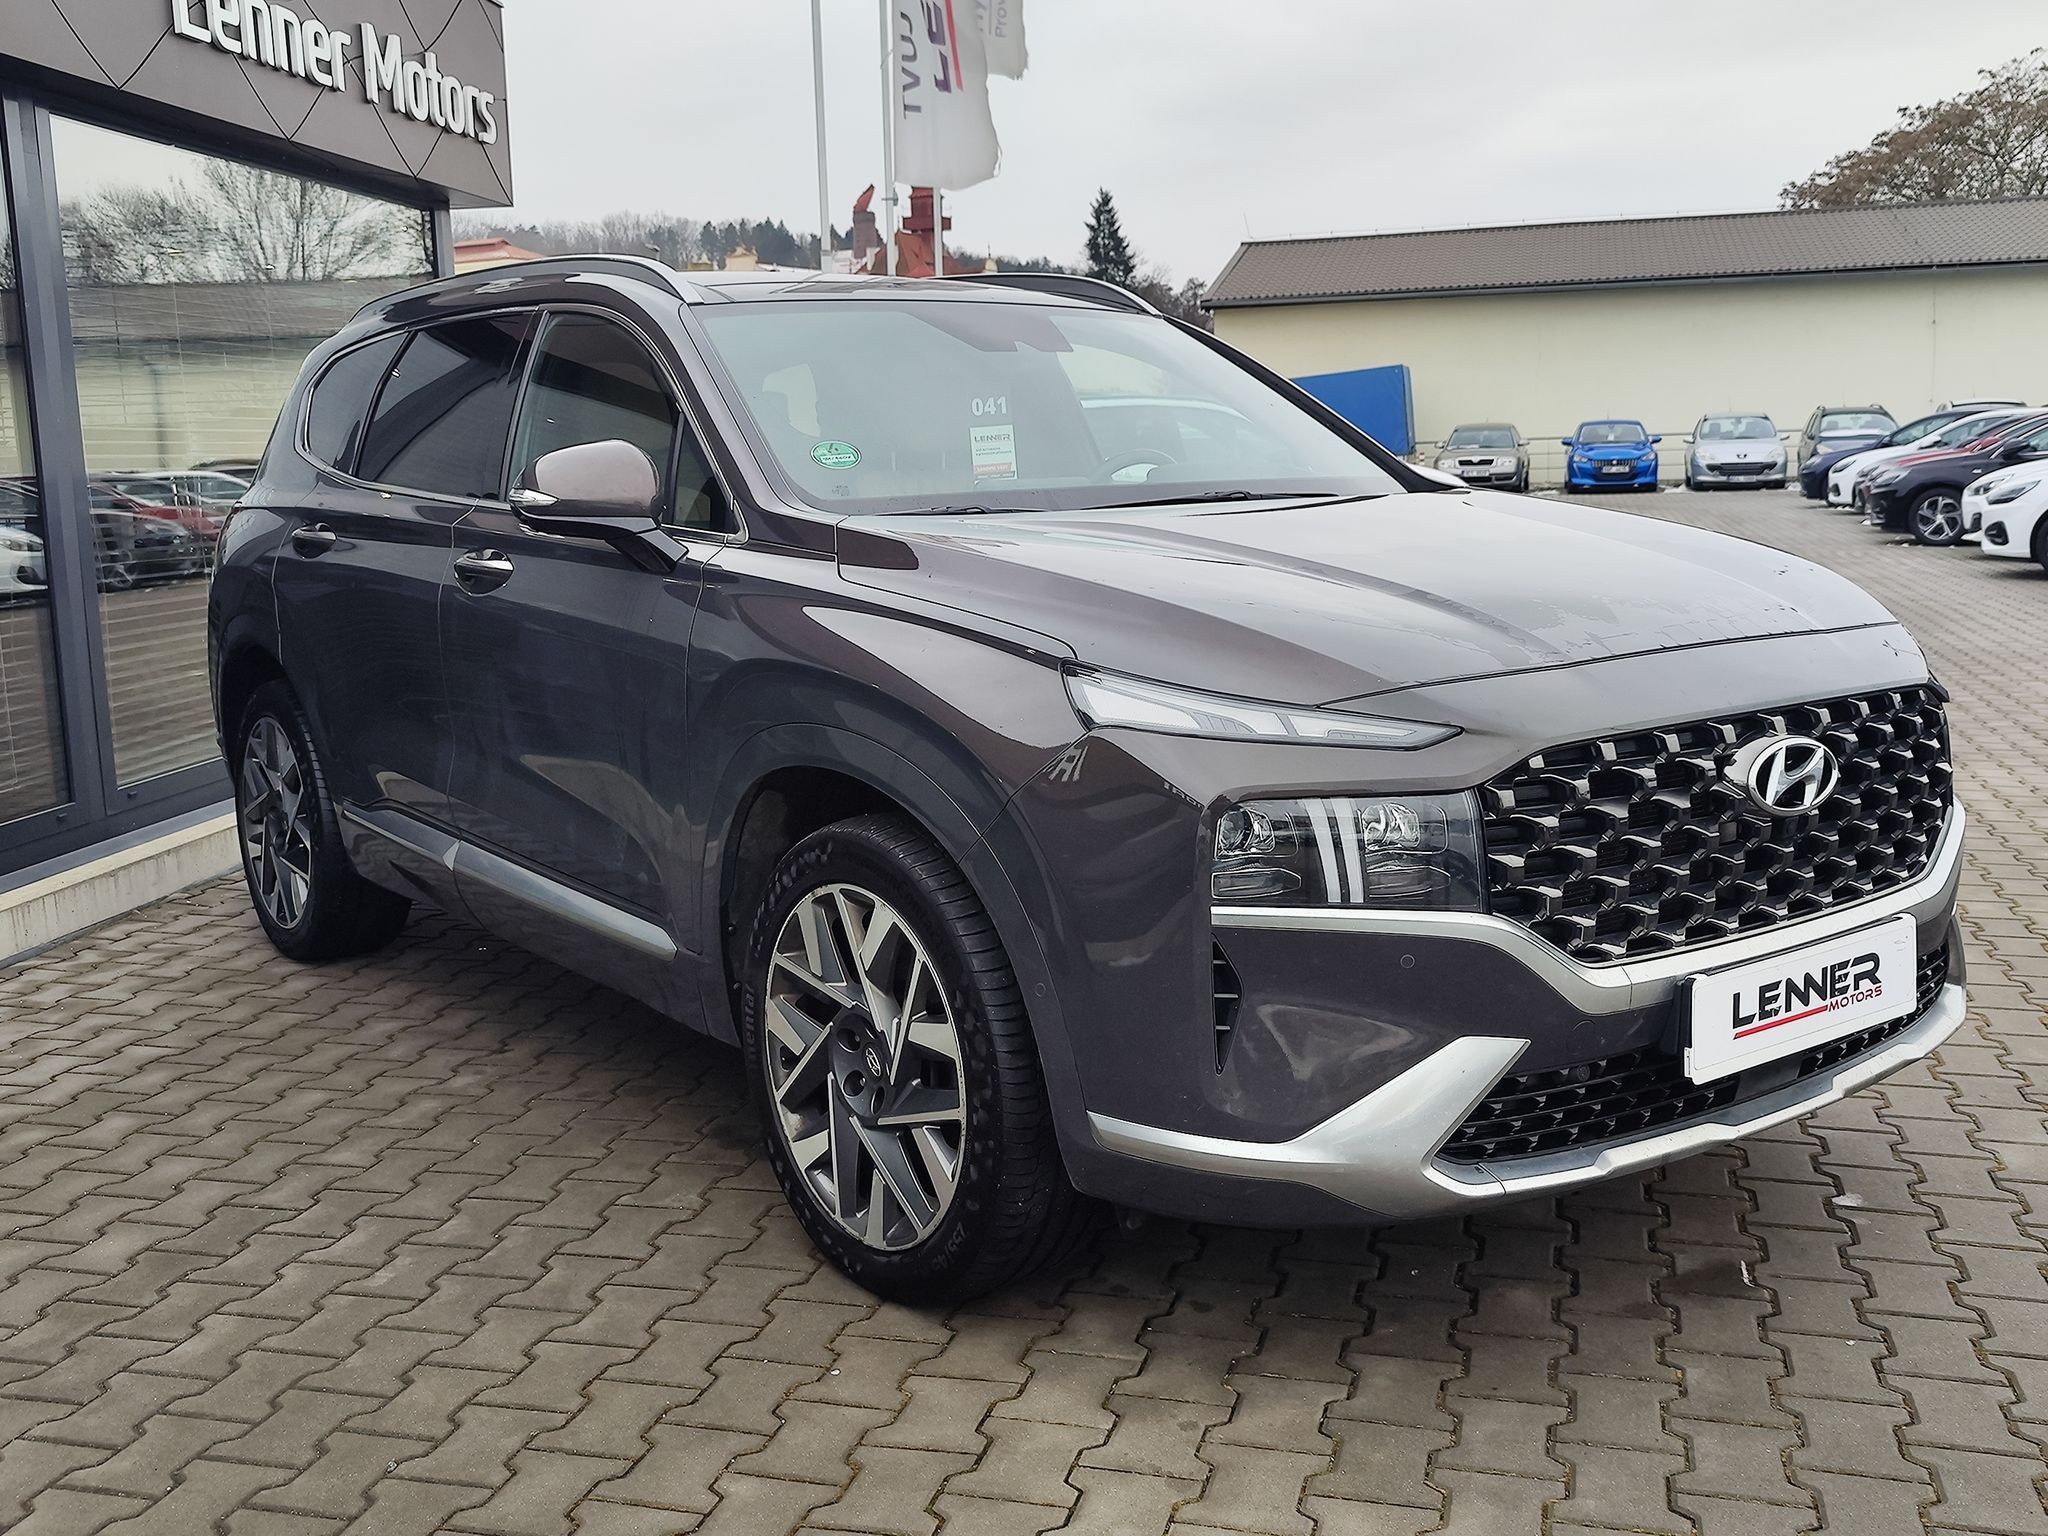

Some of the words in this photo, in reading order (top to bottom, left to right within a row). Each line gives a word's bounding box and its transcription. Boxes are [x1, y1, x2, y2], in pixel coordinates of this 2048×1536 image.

[171, 0, 352, 92] Lenner
[359, 21, 497, 145] Motors
[971, 396, 1008, 416] 041
[1731, 951, 1882, 1029] LENNER
[1828, 985, 1883, 1012] MOTORS
